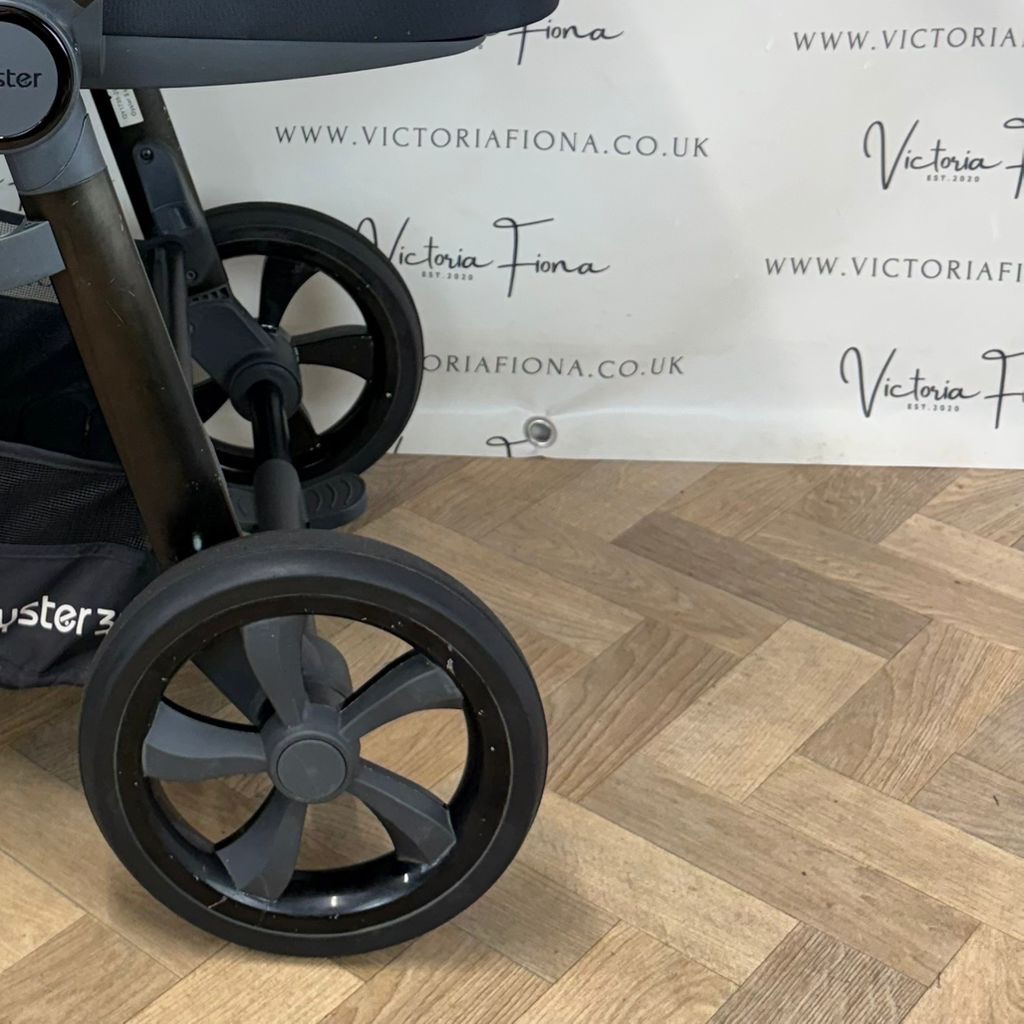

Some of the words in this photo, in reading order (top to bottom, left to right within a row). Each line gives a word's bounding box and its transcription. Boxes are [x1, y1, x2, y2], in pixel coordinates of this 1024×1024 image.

[274, 125, 709, 158] WWW.VICTORIAFIONA.CO.UK
[863, 120, 1003, 190] Victoria
[493, 217, 611, 298] Fiona
[840, 346, 981, 418] Victoria
